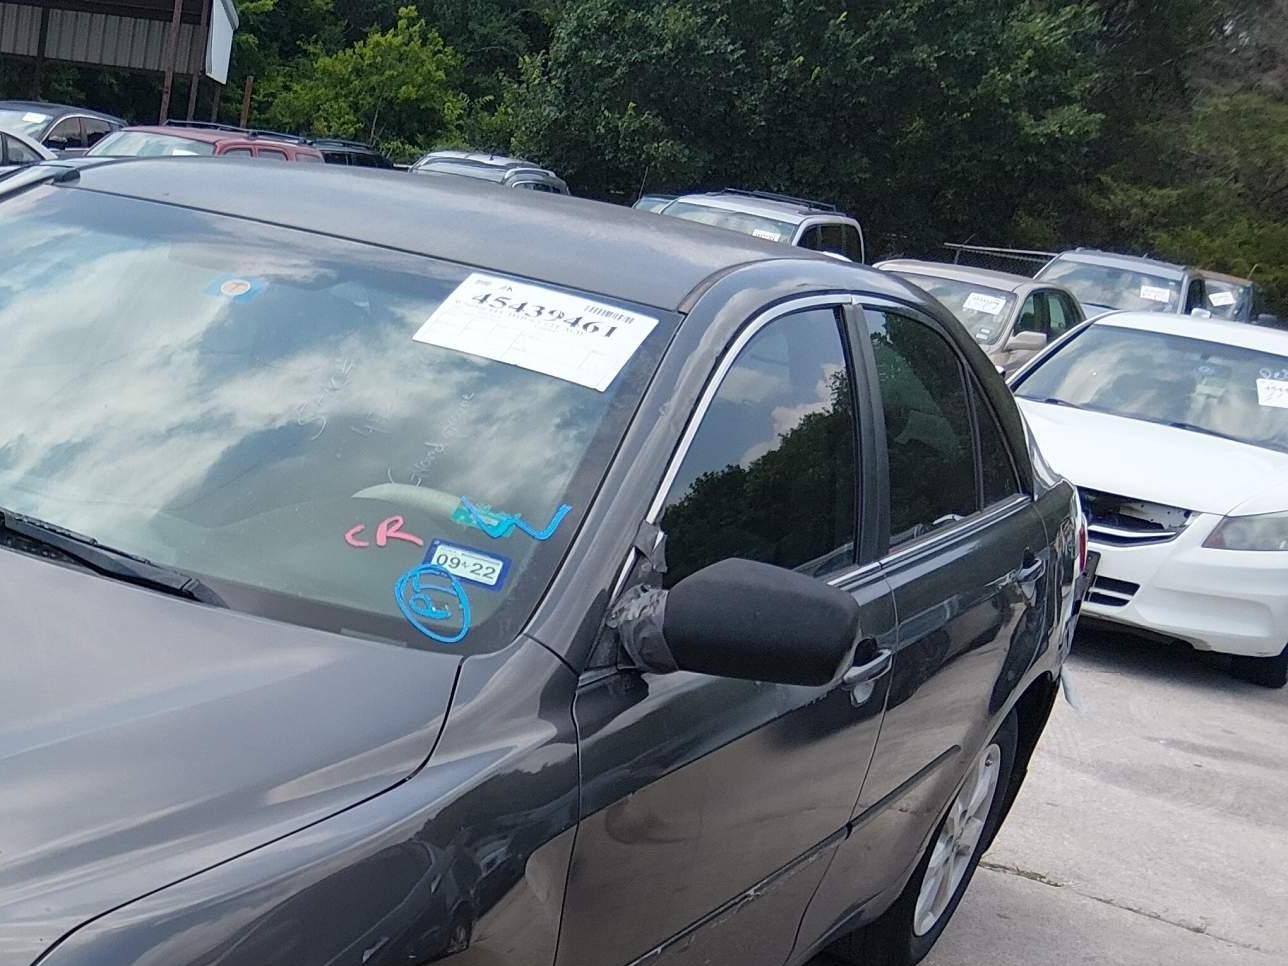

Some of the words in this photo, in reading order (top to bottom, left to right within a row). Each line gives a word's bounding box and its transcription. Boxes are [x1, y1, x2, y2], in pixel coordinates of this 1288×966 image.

[471, 292, 618, 339] 45439461
[344, 515, 425, 547] CR
[436, 553, 461, 569] 09
[470, 562, 496, 580] 22
